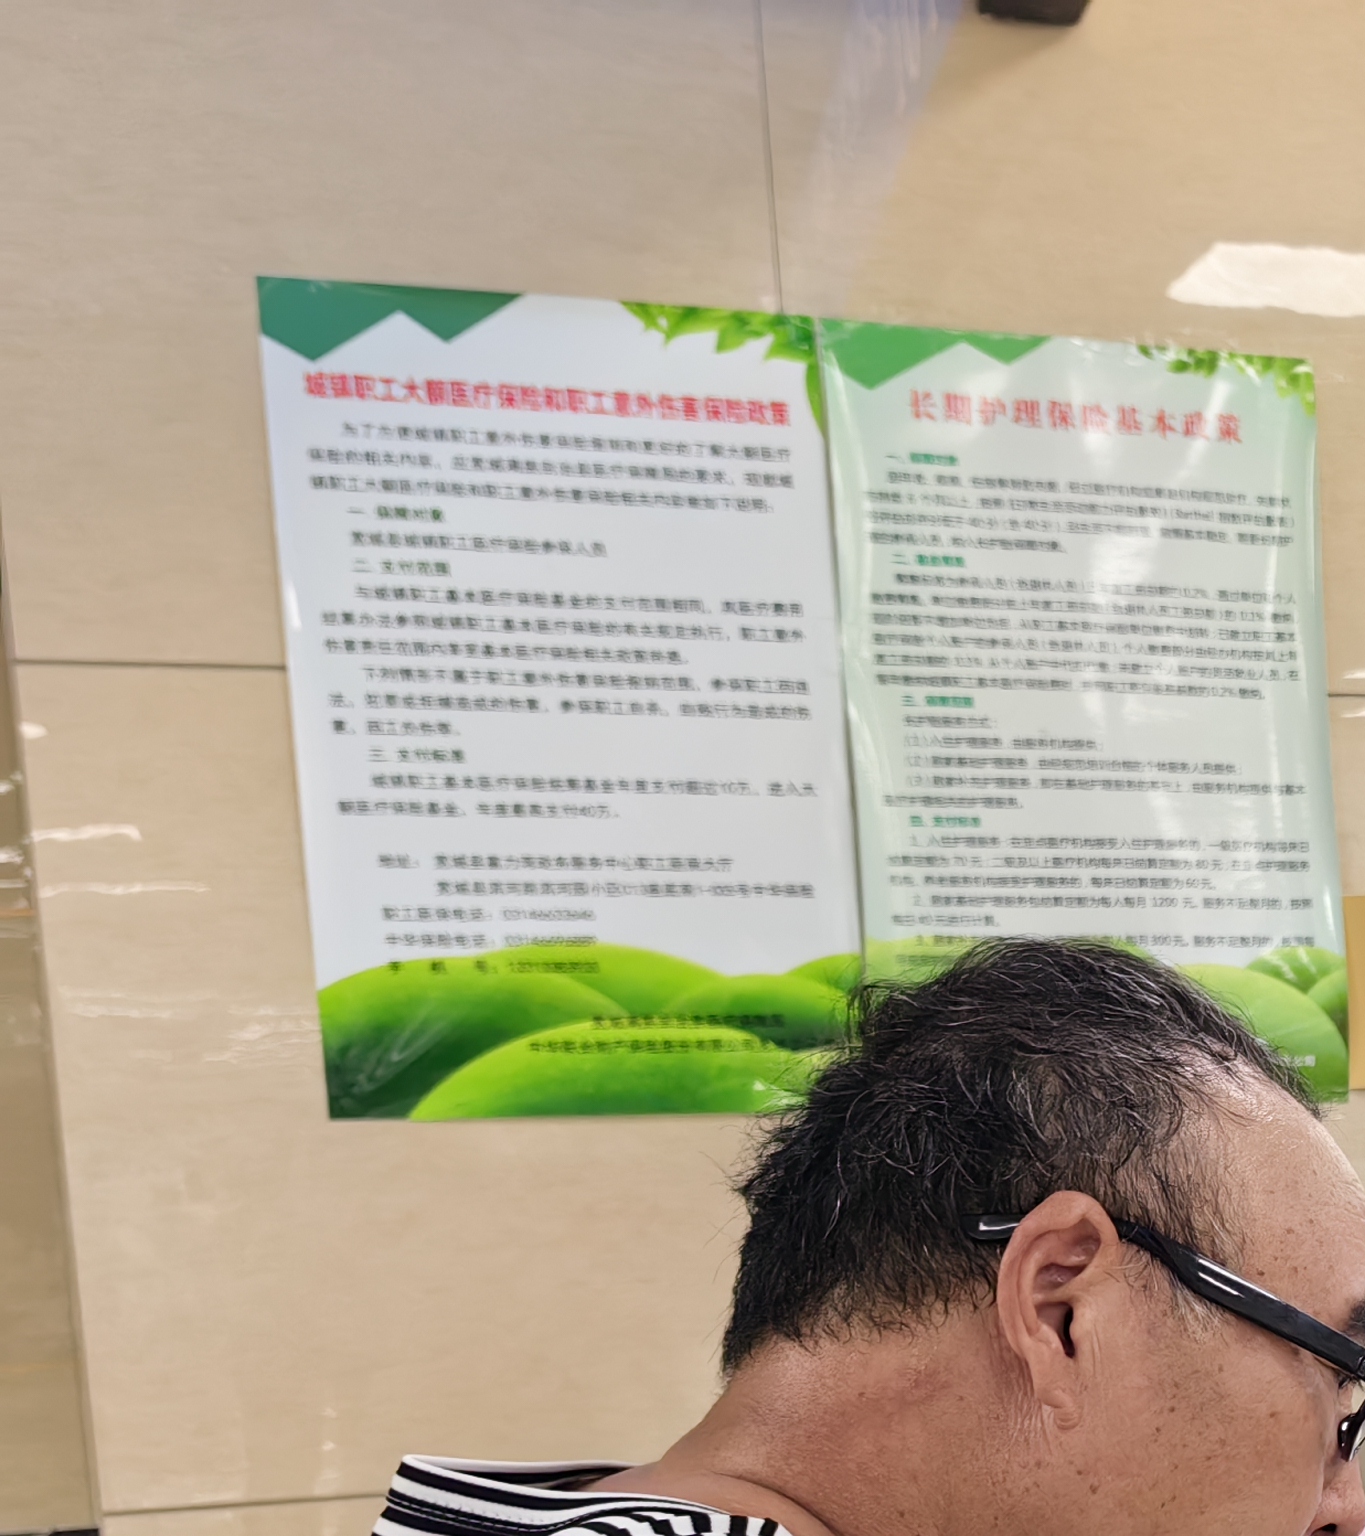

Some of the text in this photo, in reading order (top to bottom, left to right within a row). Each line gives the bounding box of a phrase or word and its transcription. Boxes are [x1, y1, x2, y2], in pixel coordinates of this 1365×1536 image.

[908, 390, 1243, 444] 长期护理保险基本政策
